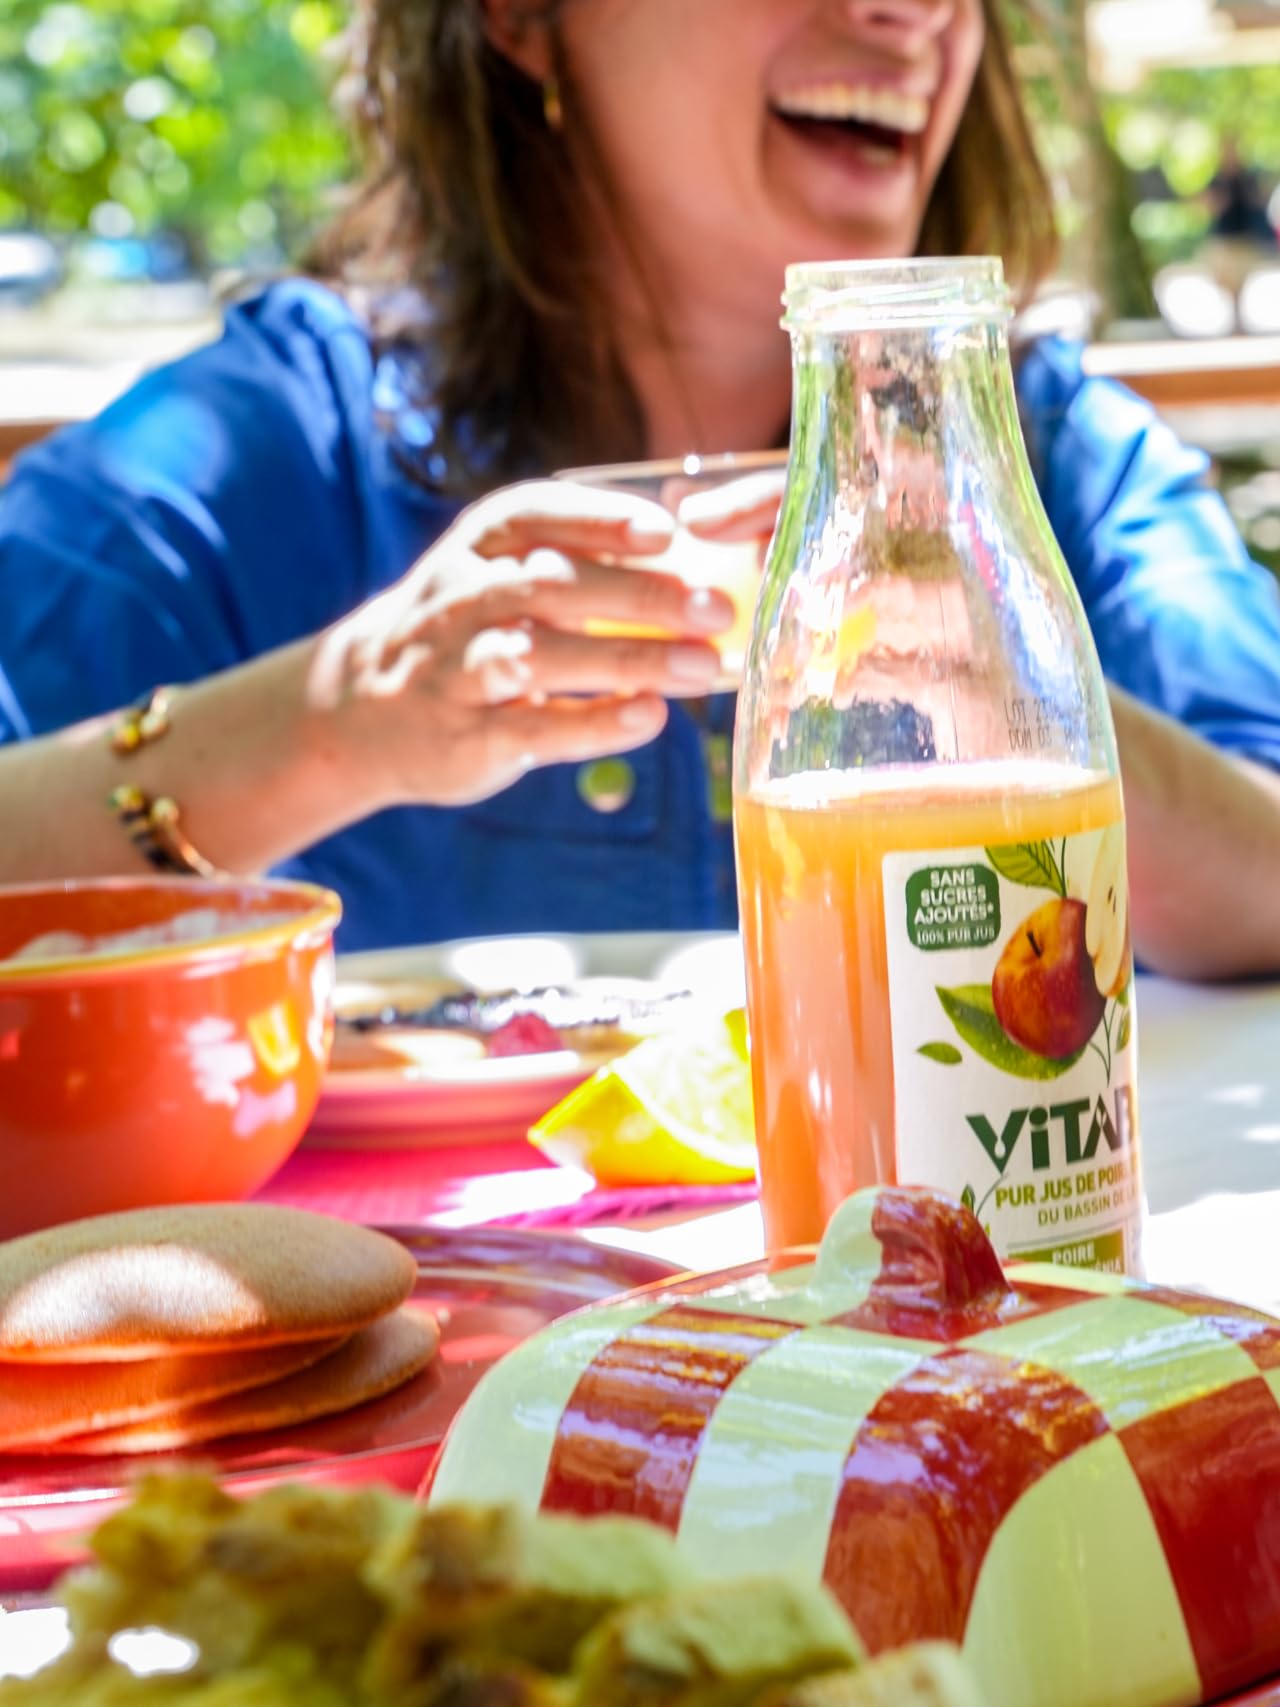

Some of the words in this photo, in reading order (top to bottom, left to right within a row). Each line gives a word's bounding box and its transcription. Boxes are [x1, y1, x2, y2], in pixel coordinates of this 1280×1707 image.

[930, 868, 975, 888] SANS
[921, 885, 987, 907] SUCRES
[916, 928, 944, 945] 100%
[947, 926, 971, 944] PUR
[973, 924, 995, 941] JUS
[995, 1183, 1036, 1208] PUR
[1040, 1177, 1073, 1203] JUS
[1076, 1170, 1096, 1195] DE
[1038, 1208, 1060, 1226] DU
[1064, 1194, 1111, 1221] BASSIN
[1052, 1240, 1095, 1265] POIRE
